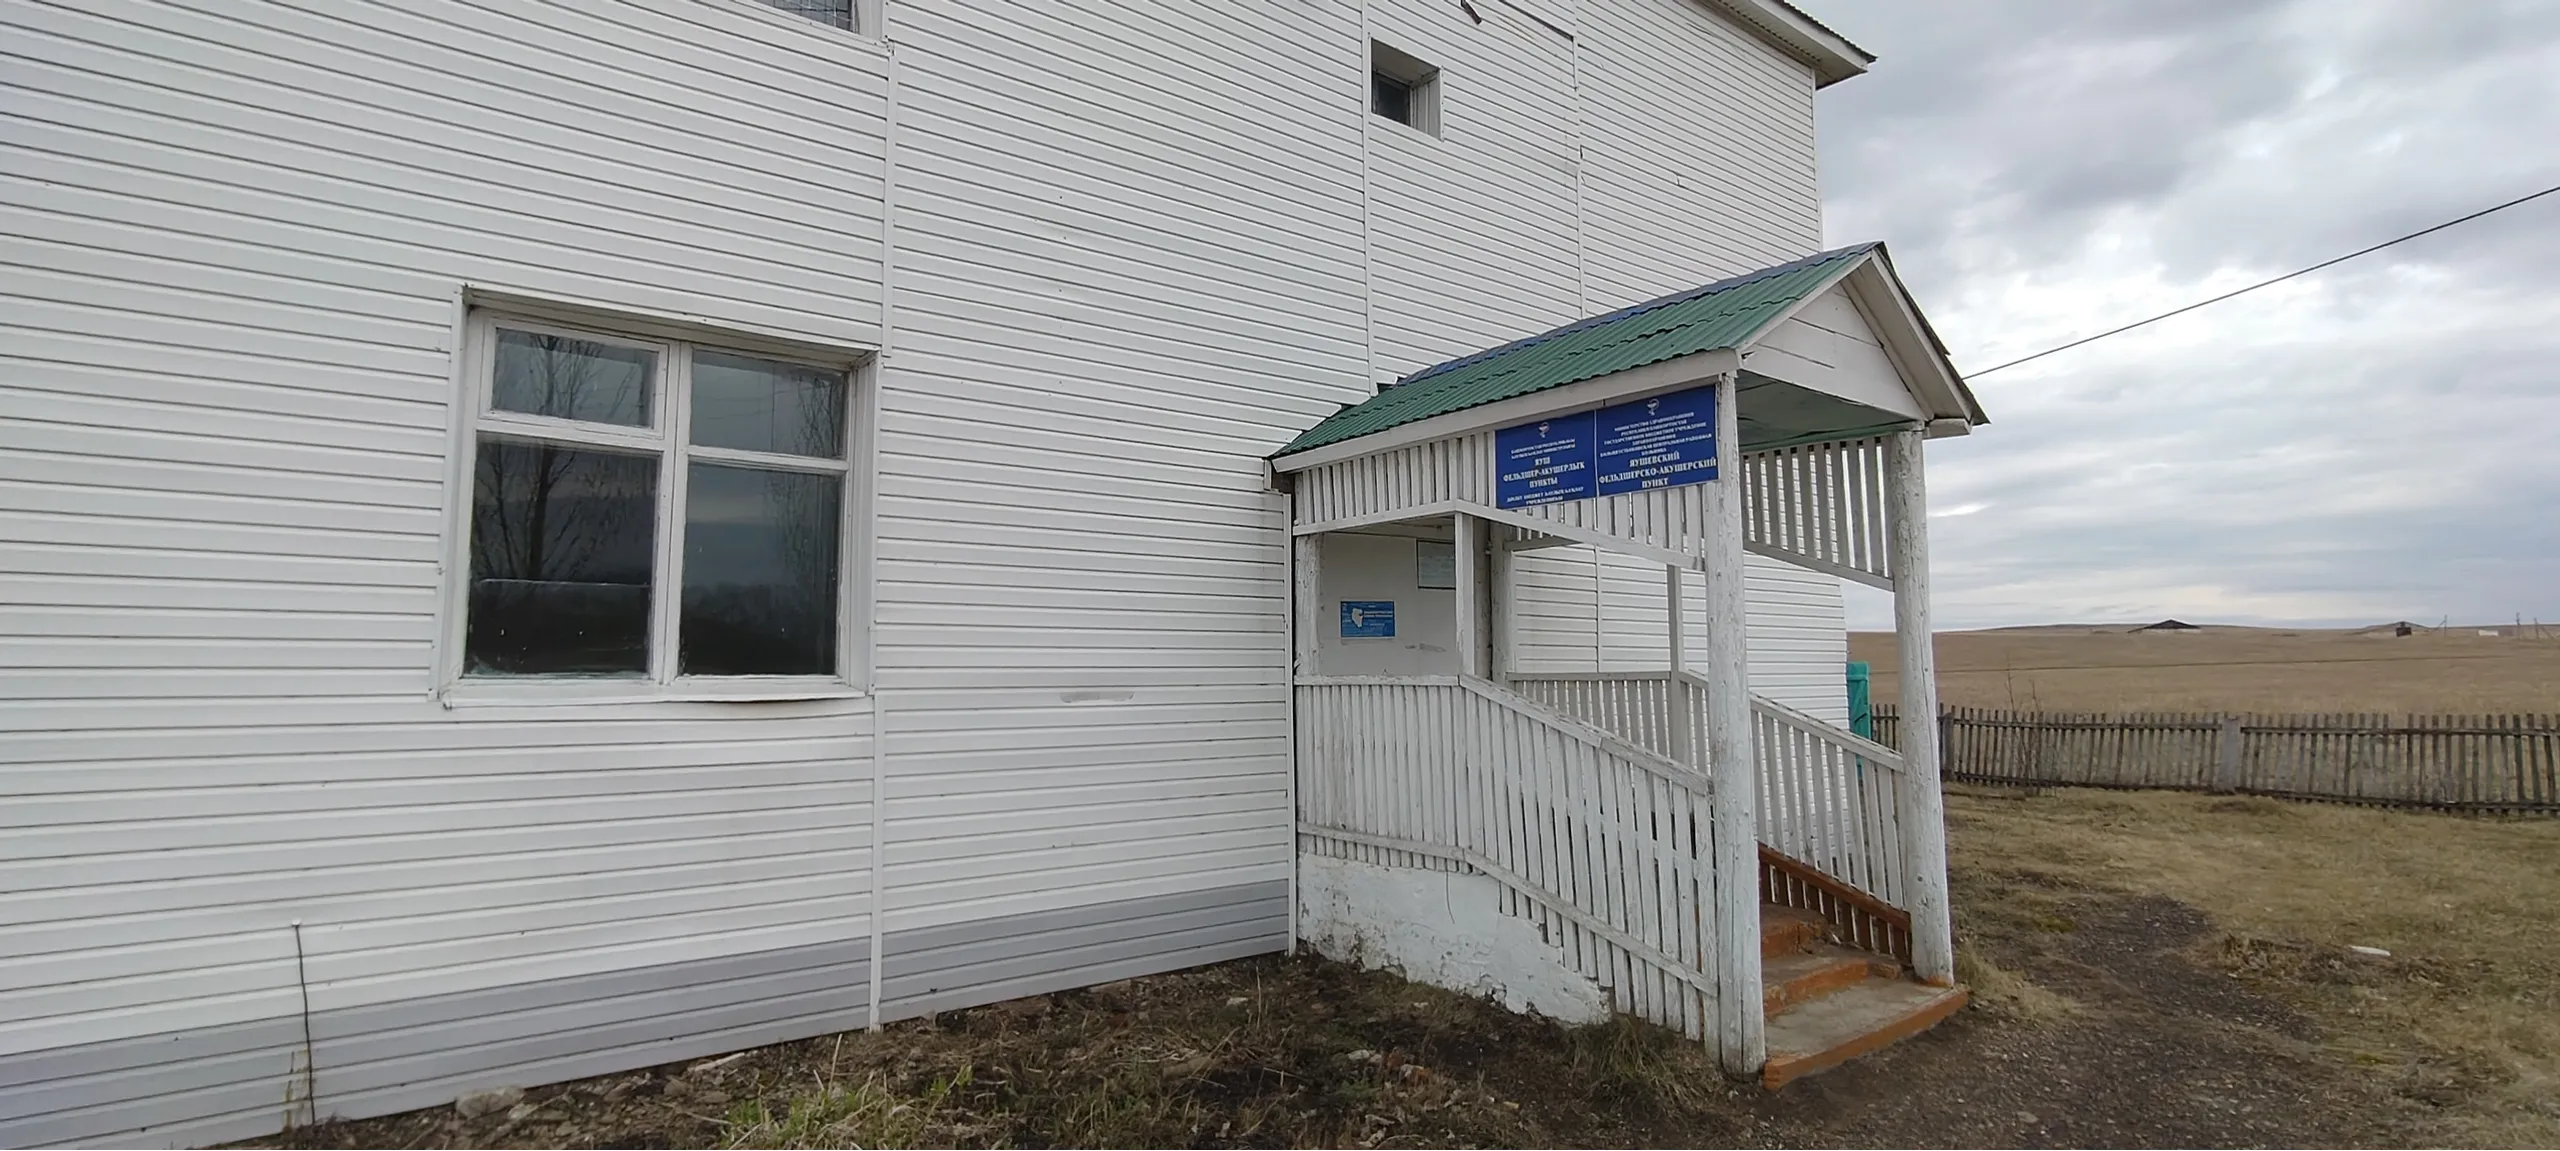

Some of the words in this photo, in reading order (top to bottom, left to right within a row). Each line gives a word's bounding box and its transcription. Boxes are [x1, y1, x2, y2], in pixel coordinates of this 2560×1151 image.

[1630, 451, 1680, 467] ЯУШЕВСКИЙ
[1599, 457, 1717, 484] ФЕЛЬДШЕРСКО-АКУШЕРСКИЙ
[1529, 477, 1558, 488] ПУНКТЫ
[1642, 478, 1668, 488] ПУНКТ
